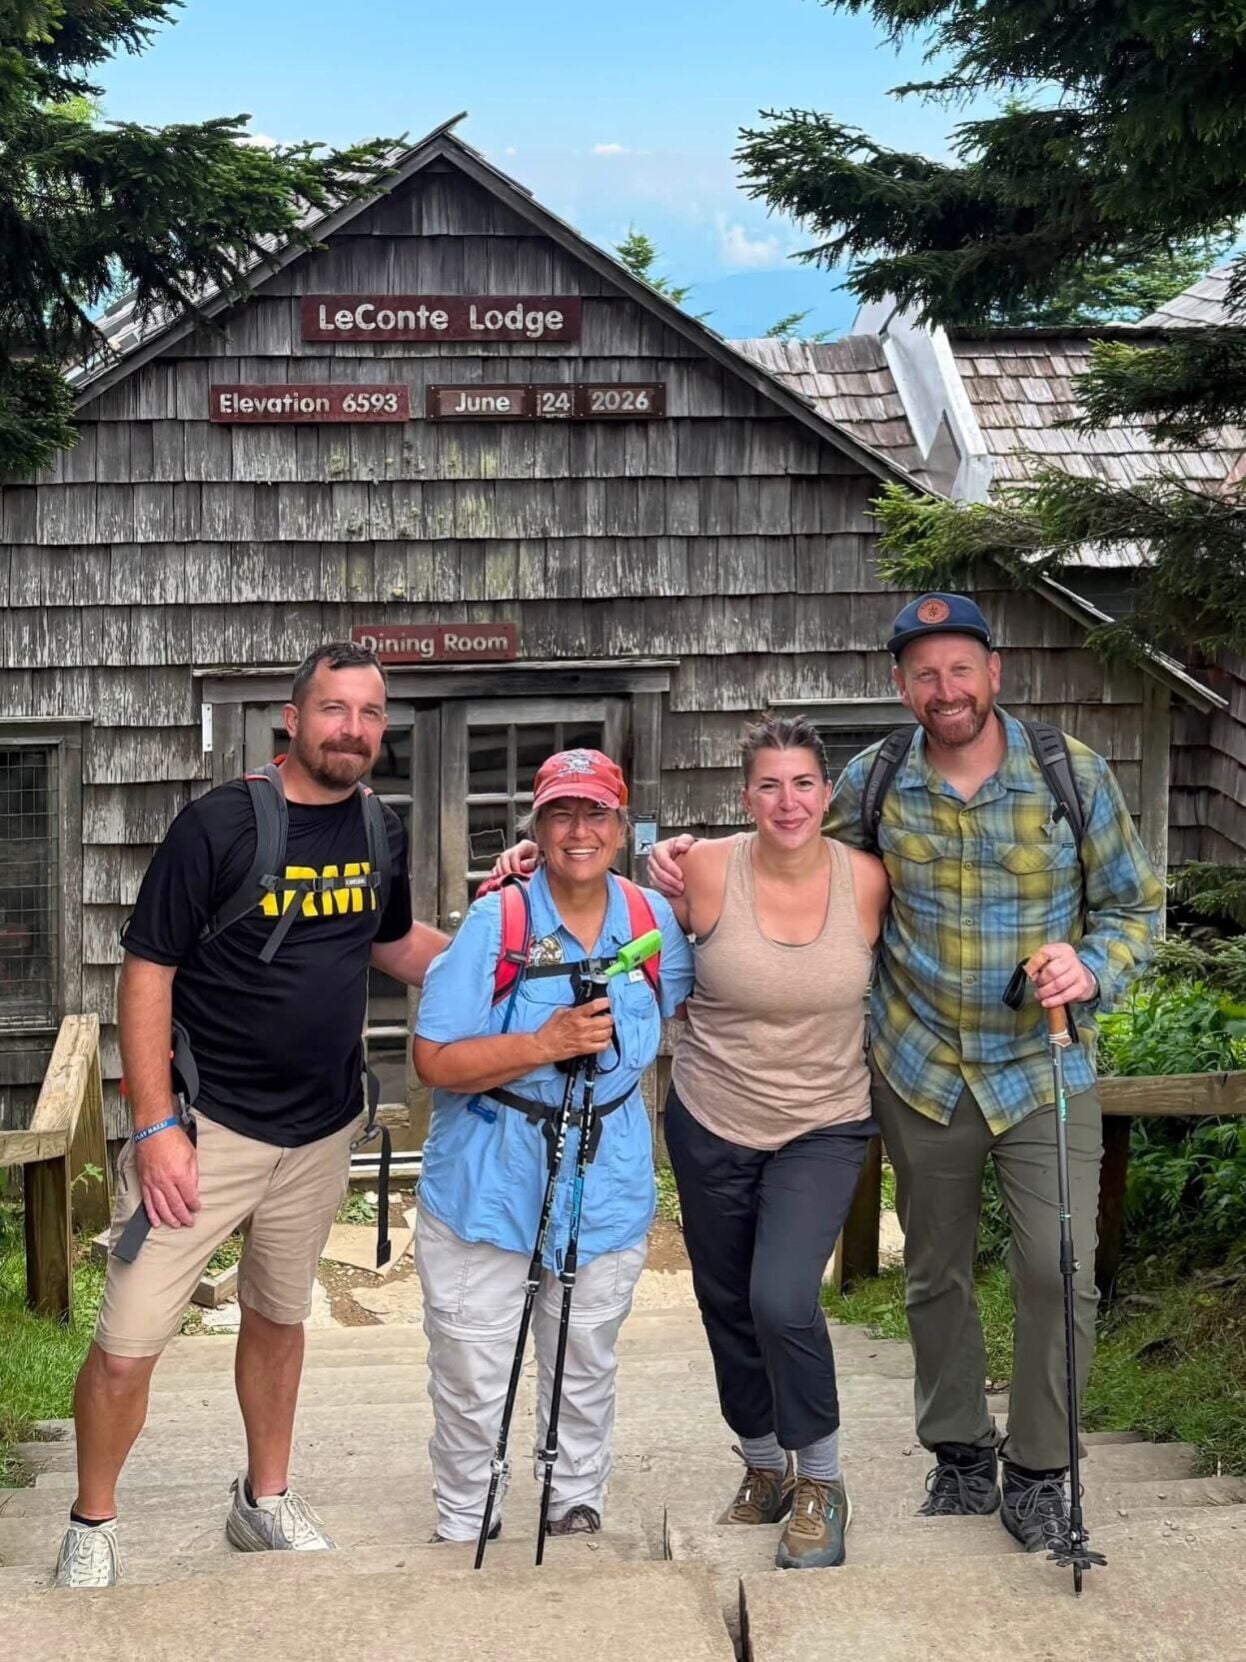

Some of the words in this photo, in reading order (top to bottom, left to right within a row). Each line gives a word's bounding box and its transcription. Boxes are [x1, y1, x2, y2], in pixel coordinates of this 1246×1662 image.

[319, 303, 449, 331] LeConte
[469, 303, 564, 338] Lodge
[219, 392, 330, 414] Elevation
[342, 392, 398, 413] 6593
[455, 392, 511, 413] June
[542, 391, 571, 412] 24
[591, 390, 649, 411] 2026
[361, 632, 435, 658] Dining
[443, 633, 508, 652] Room
[258, 862, 377, 917] RM
